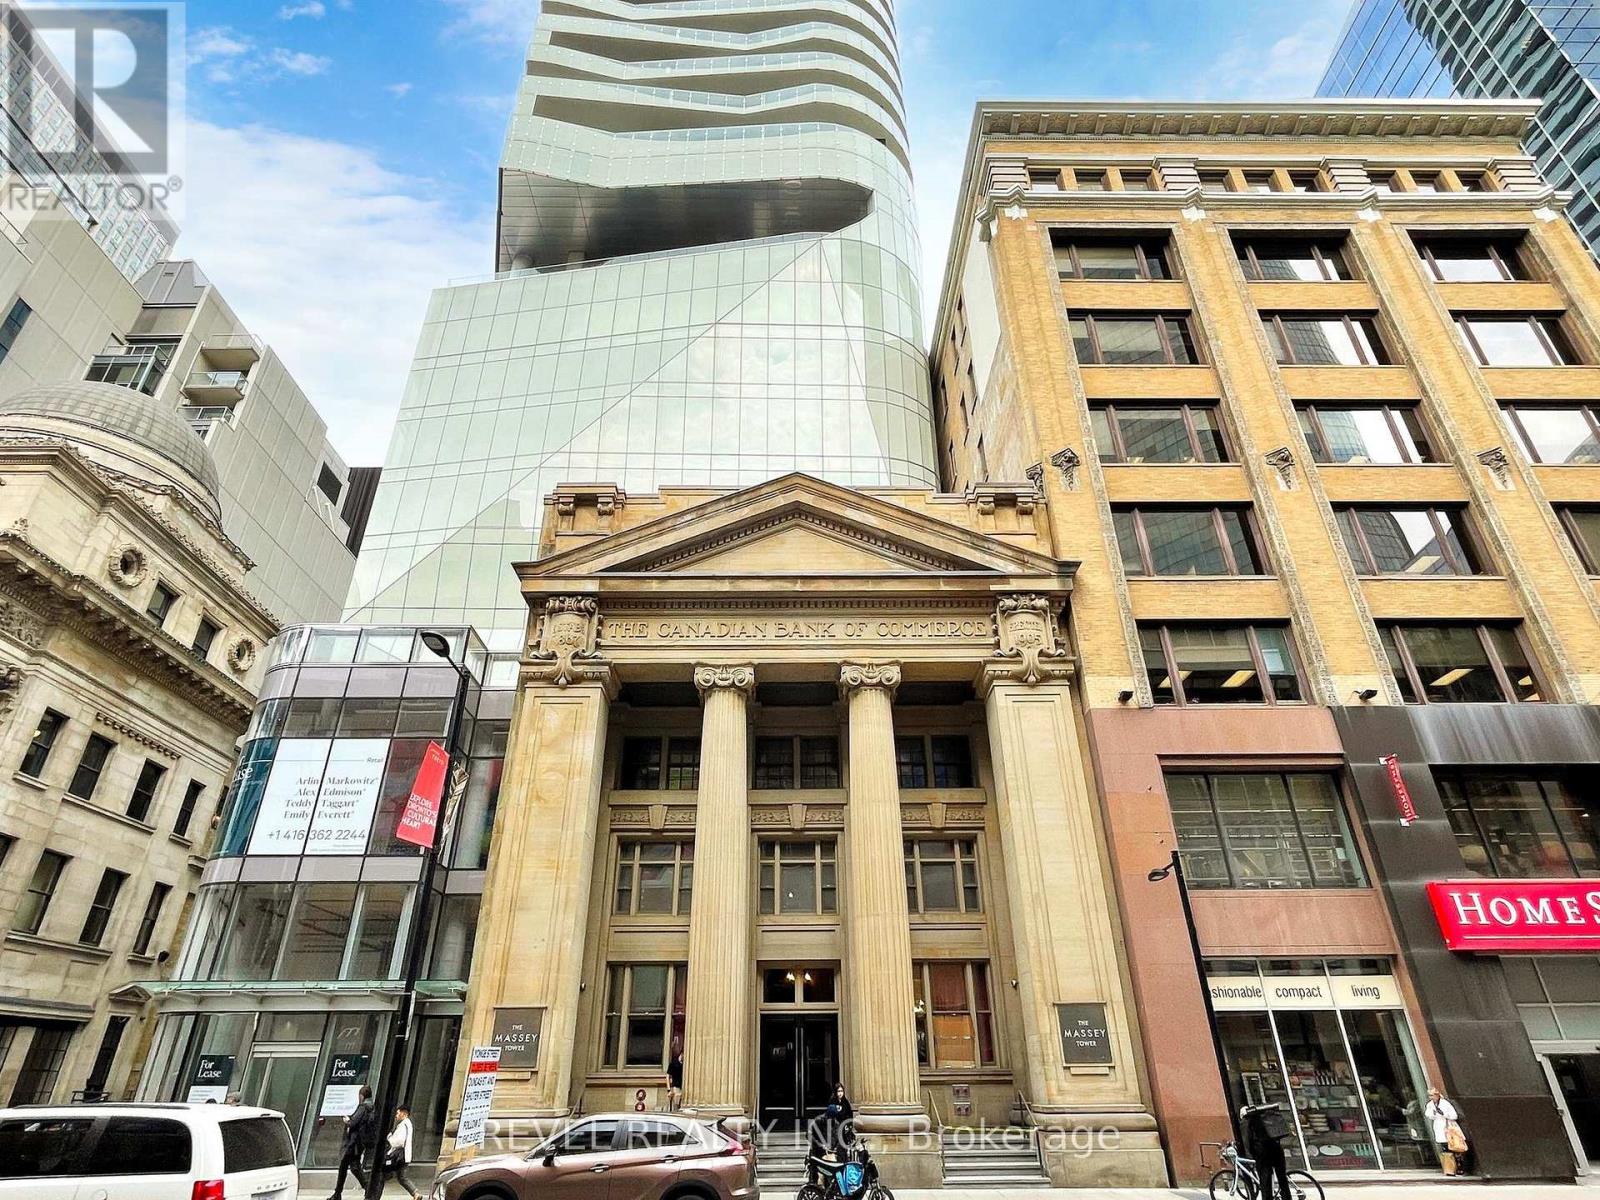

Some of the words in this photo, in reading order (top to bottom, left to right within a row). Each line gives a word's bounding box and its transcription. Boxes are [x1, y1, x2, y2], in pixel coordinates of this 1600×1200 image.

[608, 623, 649, 638] THE
[657, 623, 768, 638] CANADIAN
[774, 623, 836, 638] BANK
[844, 622, 868, 637] OF
[876, 622, 988, 637] COMMERCE
[296, 777, 319, 785] Arlin
[295, 788, 315, 796] Alex
[285, 799, 313, 808] Teddy
[284, 811, 310, 820] Emily
[268, 830, 281, 840] +1
[283, 829, 306, 840] 416
[309, 829, 333, 840] 362
[335, 829, 366, 840] 2244
[1275, 985, 1323, 1000] compact
[1351, 984, 1381, 1000] living
[494, 1033, 538, 1043] MASSEY
[1064, 1029, 1106, 1038] MASSEY
[201, 1059, 215, 1069] For
[334, 1058, 349, 1068] For
[198, 1068, 222, 1078] Lease
[331, 1066, 356, 1077] Lease
